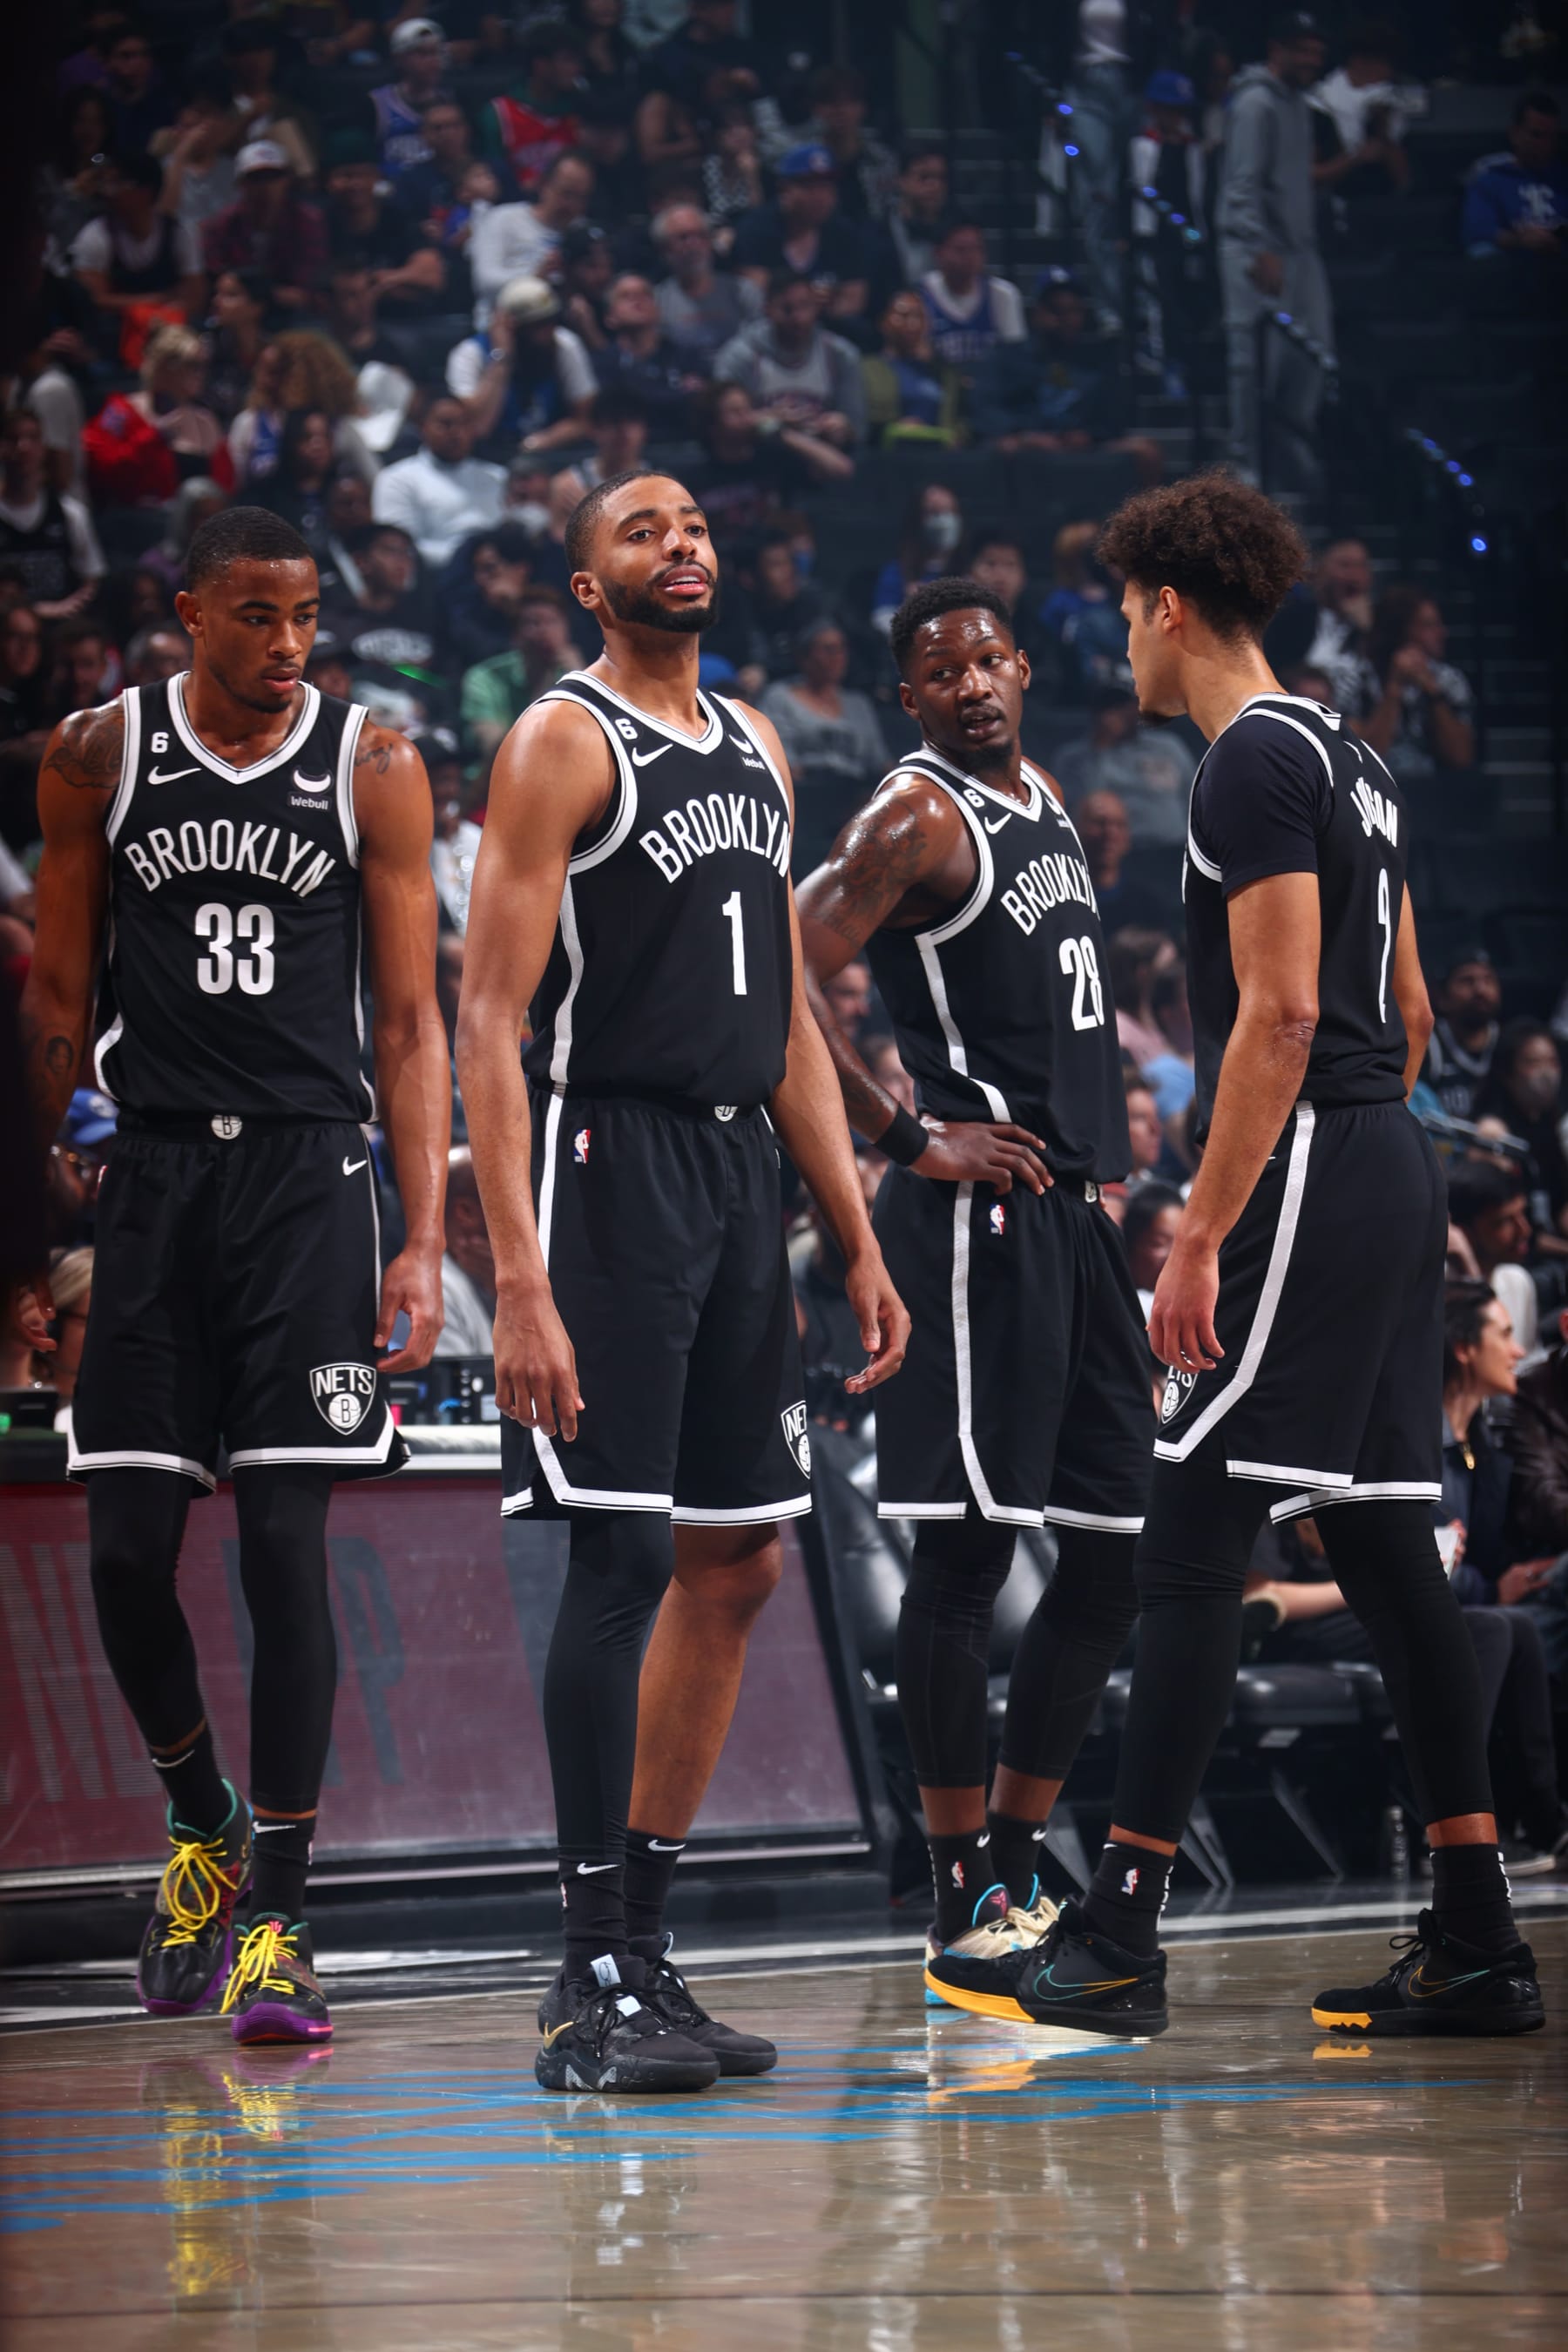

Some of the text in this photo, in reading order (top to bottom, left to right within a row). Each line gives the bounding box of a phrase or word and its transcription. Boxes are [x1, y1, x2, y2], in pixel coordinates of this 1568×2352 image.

[151, 731, 169, 754] 6
[614, 718, 638, 740] 6
[290, 794, 328, 811] Webull
[963, 787, 985, 809] 6
[124, 819, 336, 898] BROOKLYN
[194, 902, 275, 996] 33
[721, 891, 747, 996] 1
[1058, 935, 1105, 1031] 28
[314, 1367, 373, 1398] NETS
